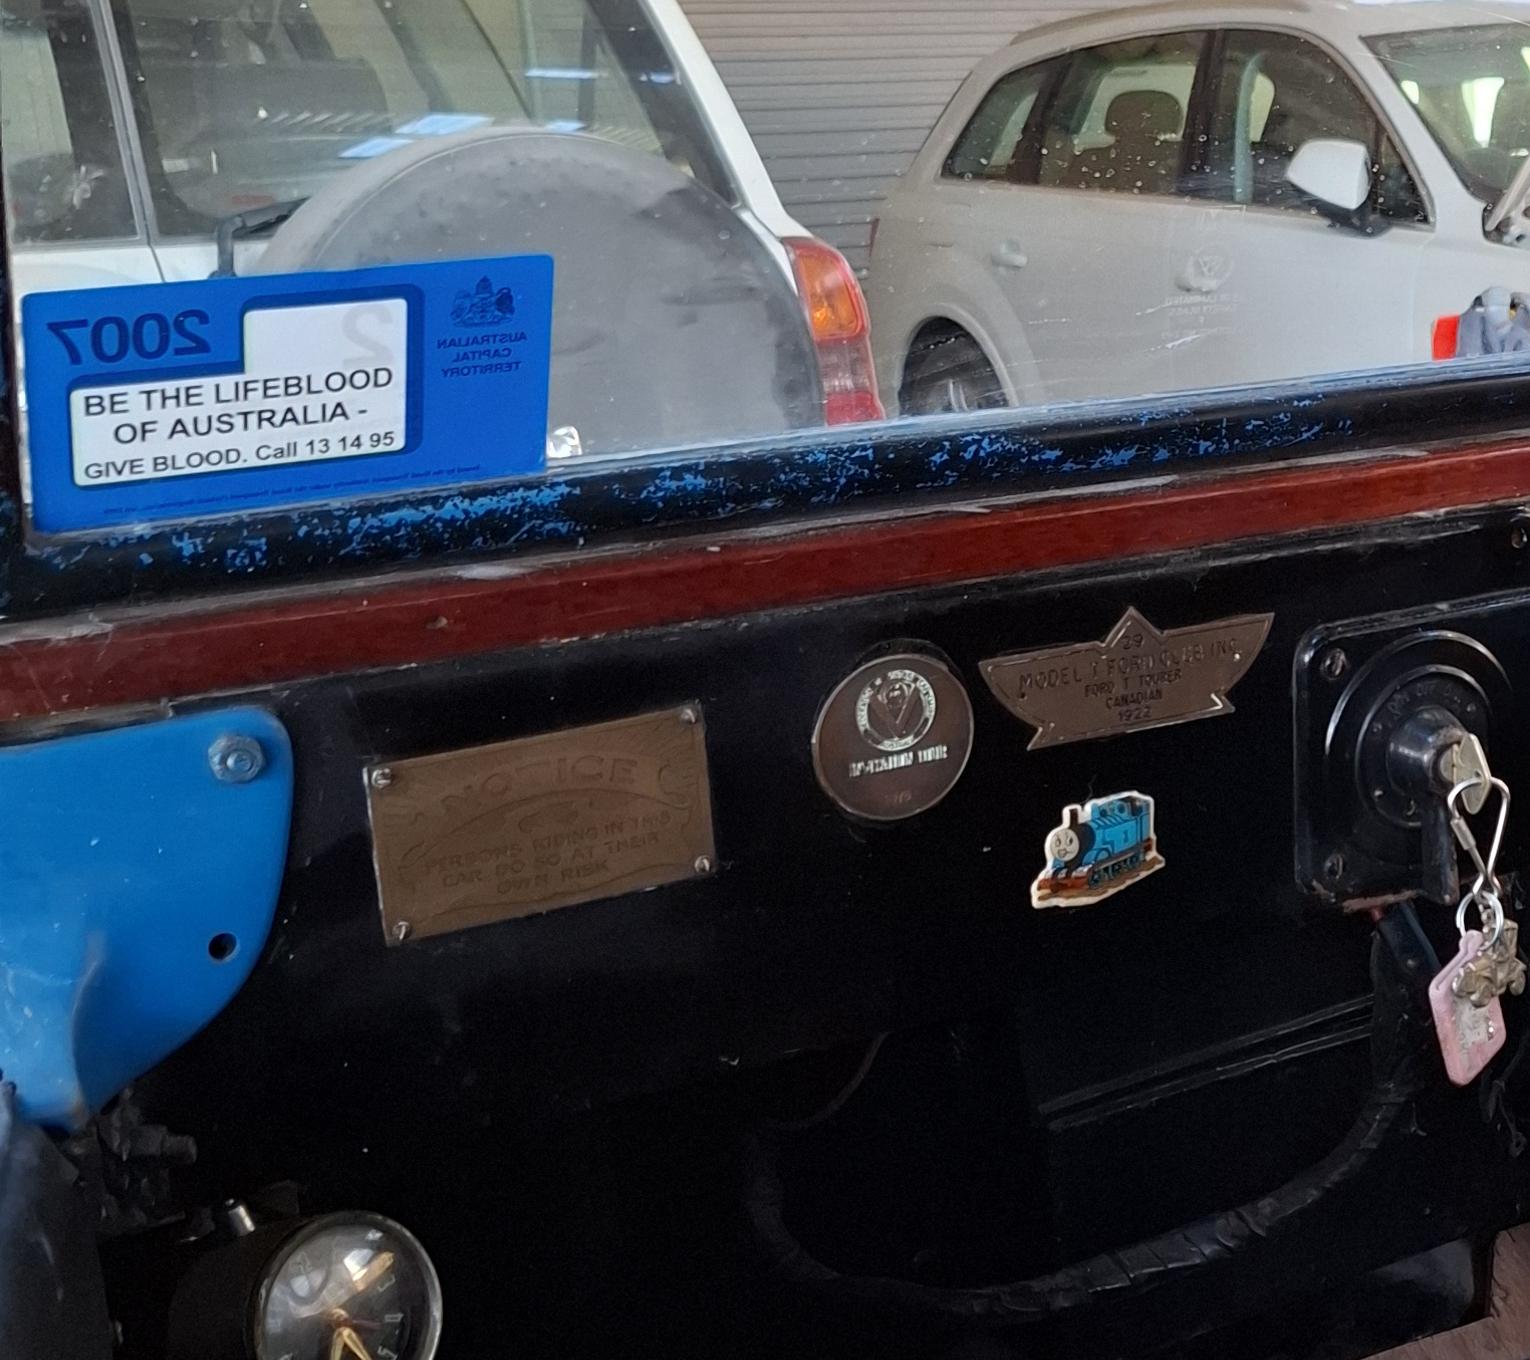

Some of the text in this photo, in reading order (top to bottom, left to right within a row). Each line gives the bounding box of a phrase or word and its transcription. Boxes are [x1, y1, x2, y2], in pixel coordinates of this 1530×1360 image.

[84, 366, 394, 417] BE THE LIFEBLOOD
[113, 420, 158, 445] OF
[168, 401, 350, 439] AUSTRALIA
[85, 429, 396, 479] GIVE BLOOD. Call 13 14 95
[1019, 666, 1083, 691] MODEL
[1107, 653, 1156, 677] FORD
[1158, 644, 1205, 666] CLUB
[1084, 682, 1116, 698] FORD
[1138, 669, 1183, 687] TOURER
[1105, 688, 1163, 710] CANADIAN
[1117, 706, 1152, 722] 1922
[532, 827, 599, 853] RIDING
[442, 866, 484, 888] CAR
[571, 846, 595, 861] AT
[560, 860, 609, 880] RISK
